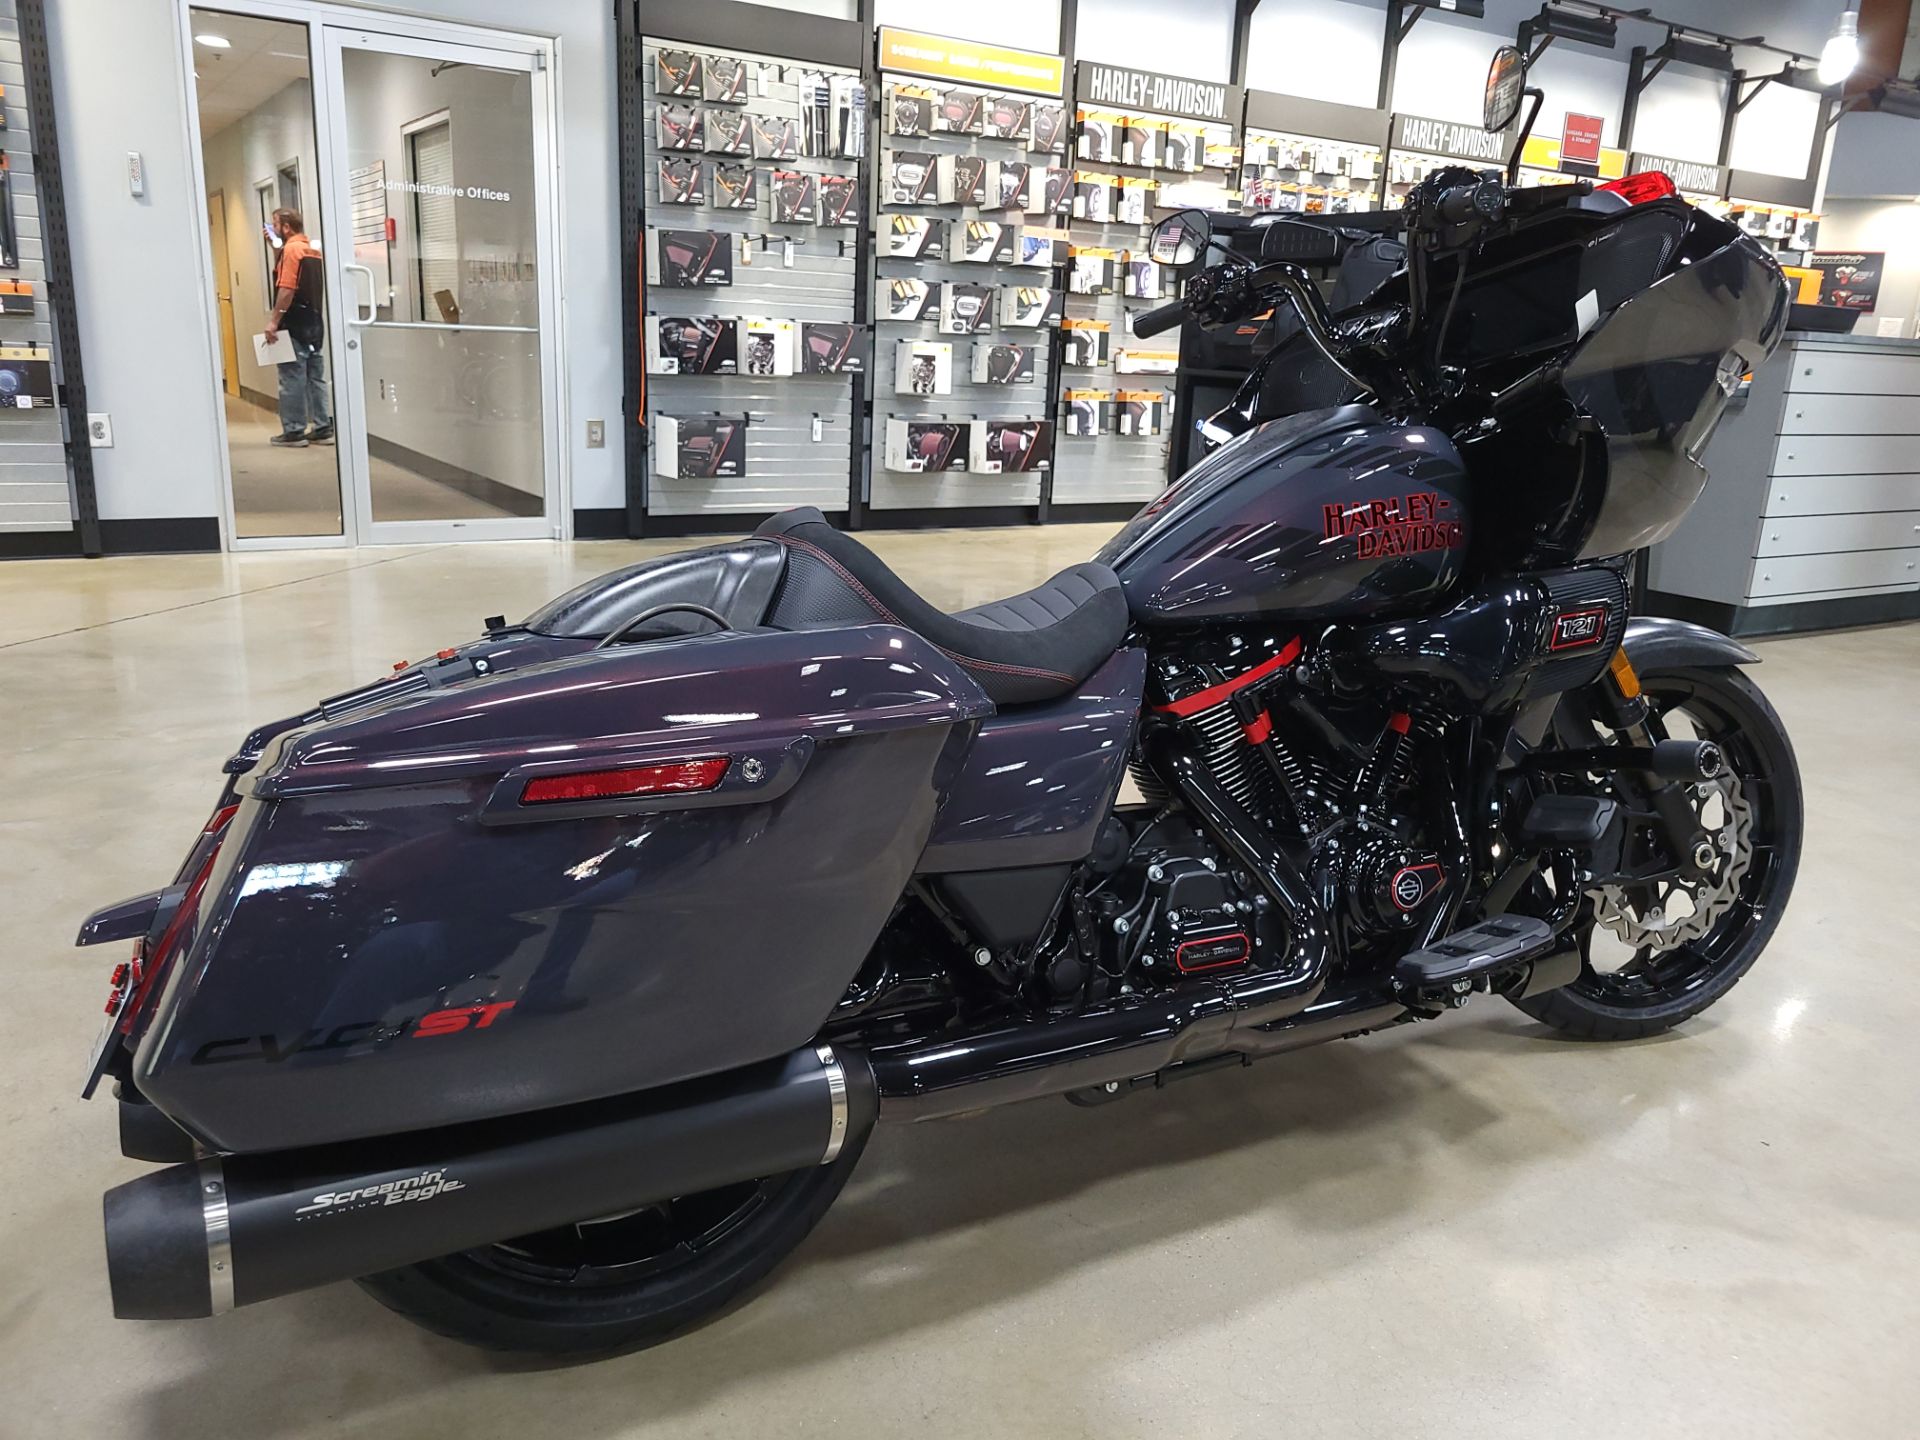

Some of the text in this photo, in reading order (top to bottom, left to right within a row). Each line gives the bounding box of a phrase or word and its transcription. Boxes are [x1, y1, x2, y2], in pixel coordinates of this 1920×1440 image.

[1090, 66, 1226, 119] HARLEY-DAVIDSON
[1401, 117, 1505, 160] HARLEY-DAVIDSON
[377, 178, 511, 201] Administrative Offices
[1322, 492, 1453, 540] HARLEY-
[1561, 616, 1596, 638] 121
[412, 1000, 517, 1038] ST
[295, 1167, 448, 1214] Screamin'
[383, 1178, 467, 1206] Eagle
[295, 1199, 380, 1222] TITANIUM
